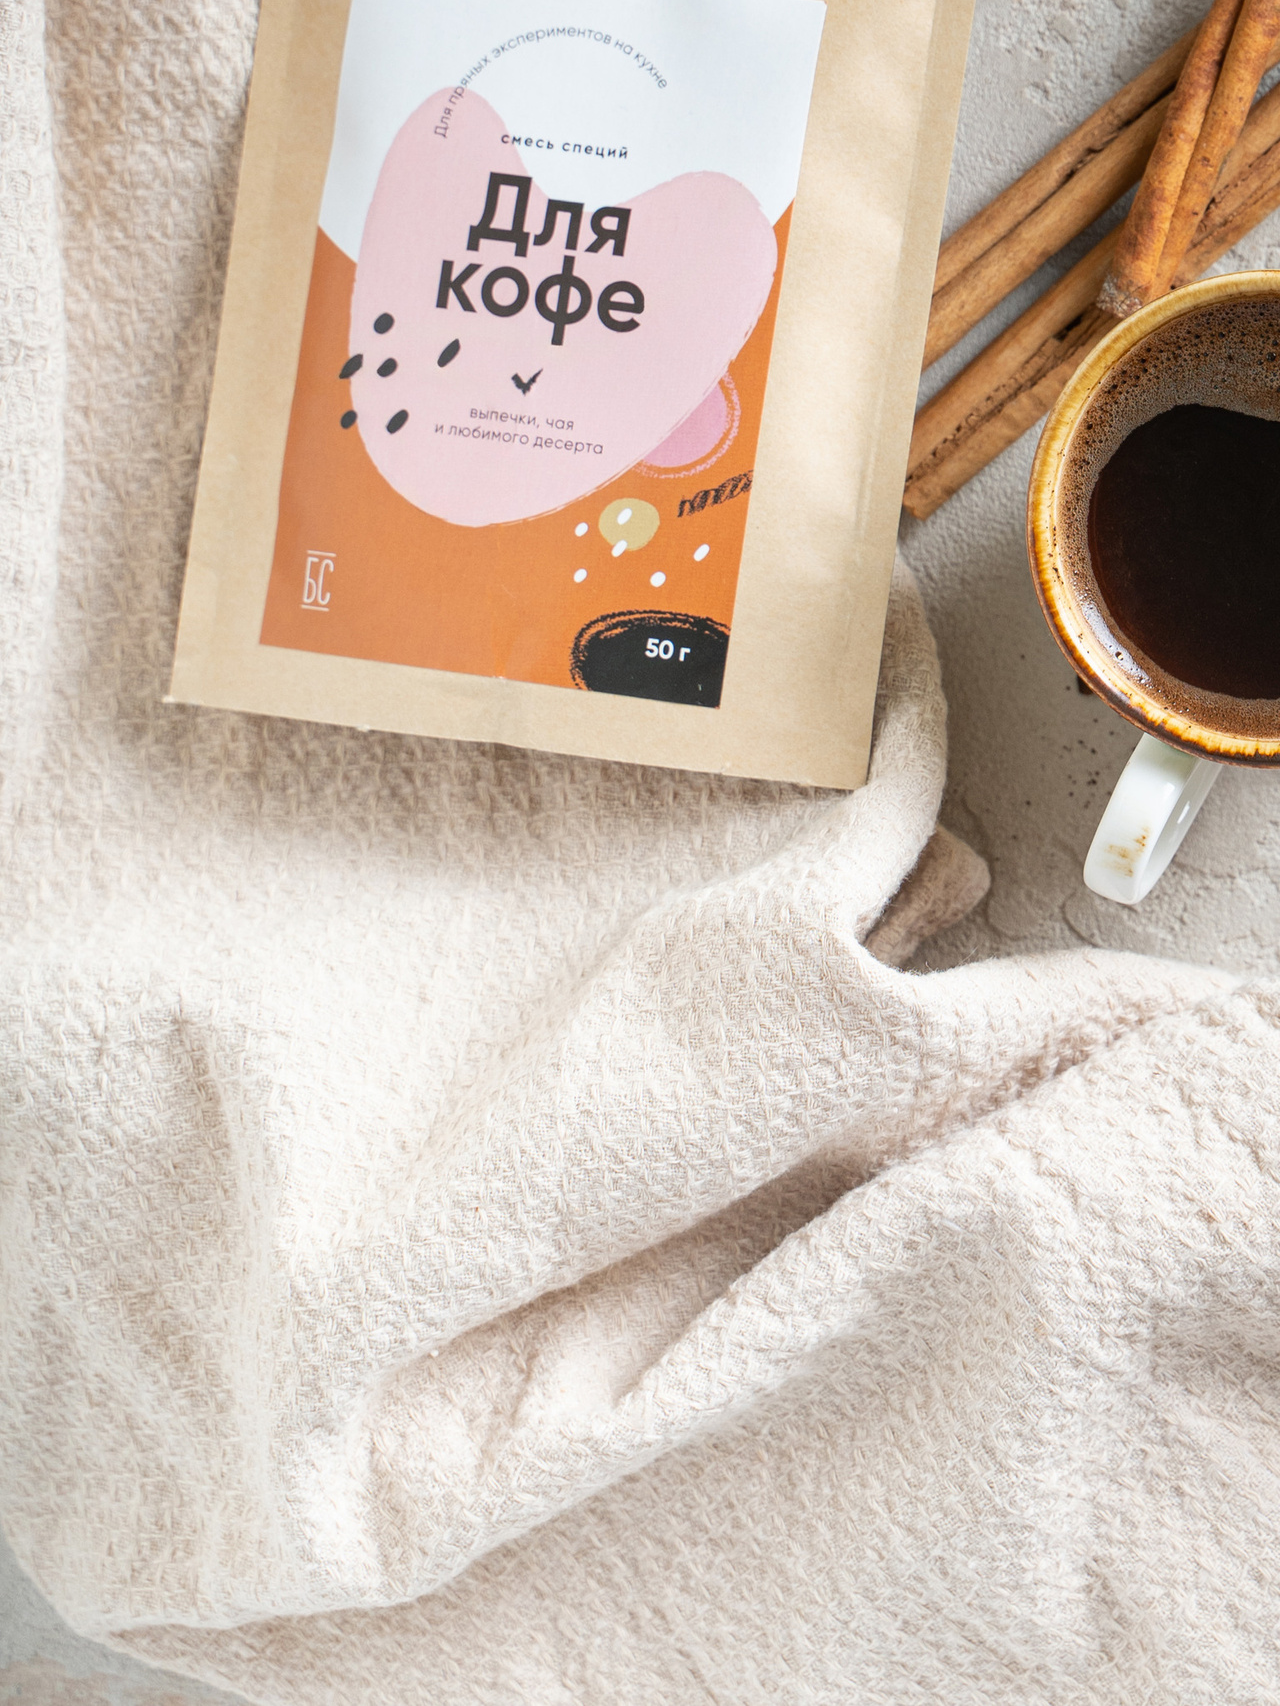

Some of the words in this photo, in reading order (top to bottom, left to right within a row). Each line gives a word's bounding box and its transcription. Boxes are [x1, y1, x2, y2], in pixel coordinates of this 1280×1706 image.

[433, 106, 454, 139] Для
[448, 54, 493, 106] пряных
[490, 25, 613, 60] экспериментов
[614, 38, 634, 56] на
[633, 52, 668, 90] кухне
[500, 133, 555, 150] смесь
[561, 141, 629, 160] специй
[466, 171, 633, 258] Для
[435, 254, 645, 346] кофе
[469, 407, 541, 429] выпечки,
[545, 417, 575, 431] чая
[434, 423, 444, 435] и
[447, 424, 530, 446] любимого
[533, 435, 604, 456] десерта
[644, 636, 676, 661] 50
[678, 646, 692, 662] г
